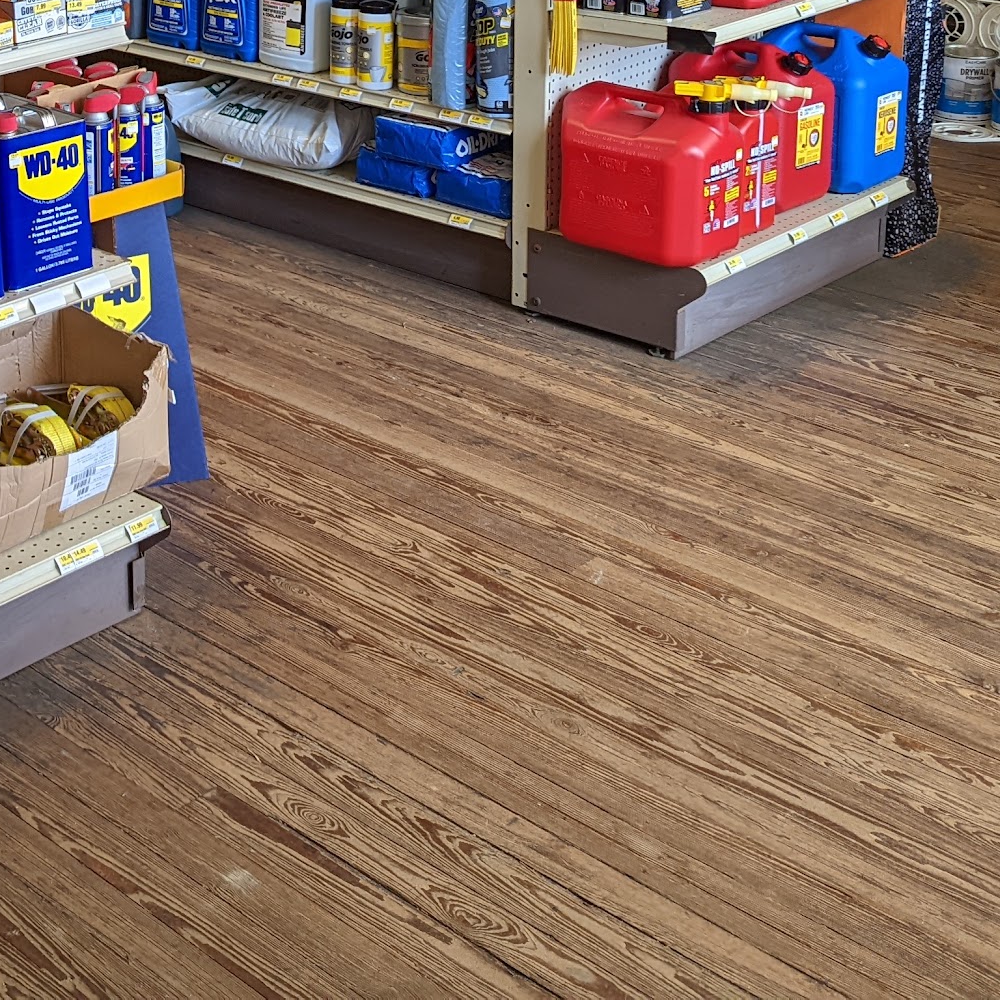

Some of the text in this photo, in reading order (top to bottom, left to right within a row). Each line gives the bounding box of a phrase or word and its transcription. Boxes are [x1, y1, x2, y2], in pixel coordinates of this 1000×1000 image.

[960, 67, 989, 77] DRYWALL
[879, 106, 896, 118] KEROSENE
[800, 118, 820, 131] GASOLINE
[24, 143, 79, 179] WD-40
[710, 159, 735, 176] NO-SPILL
[131, 522, 143, 531] 11.99
